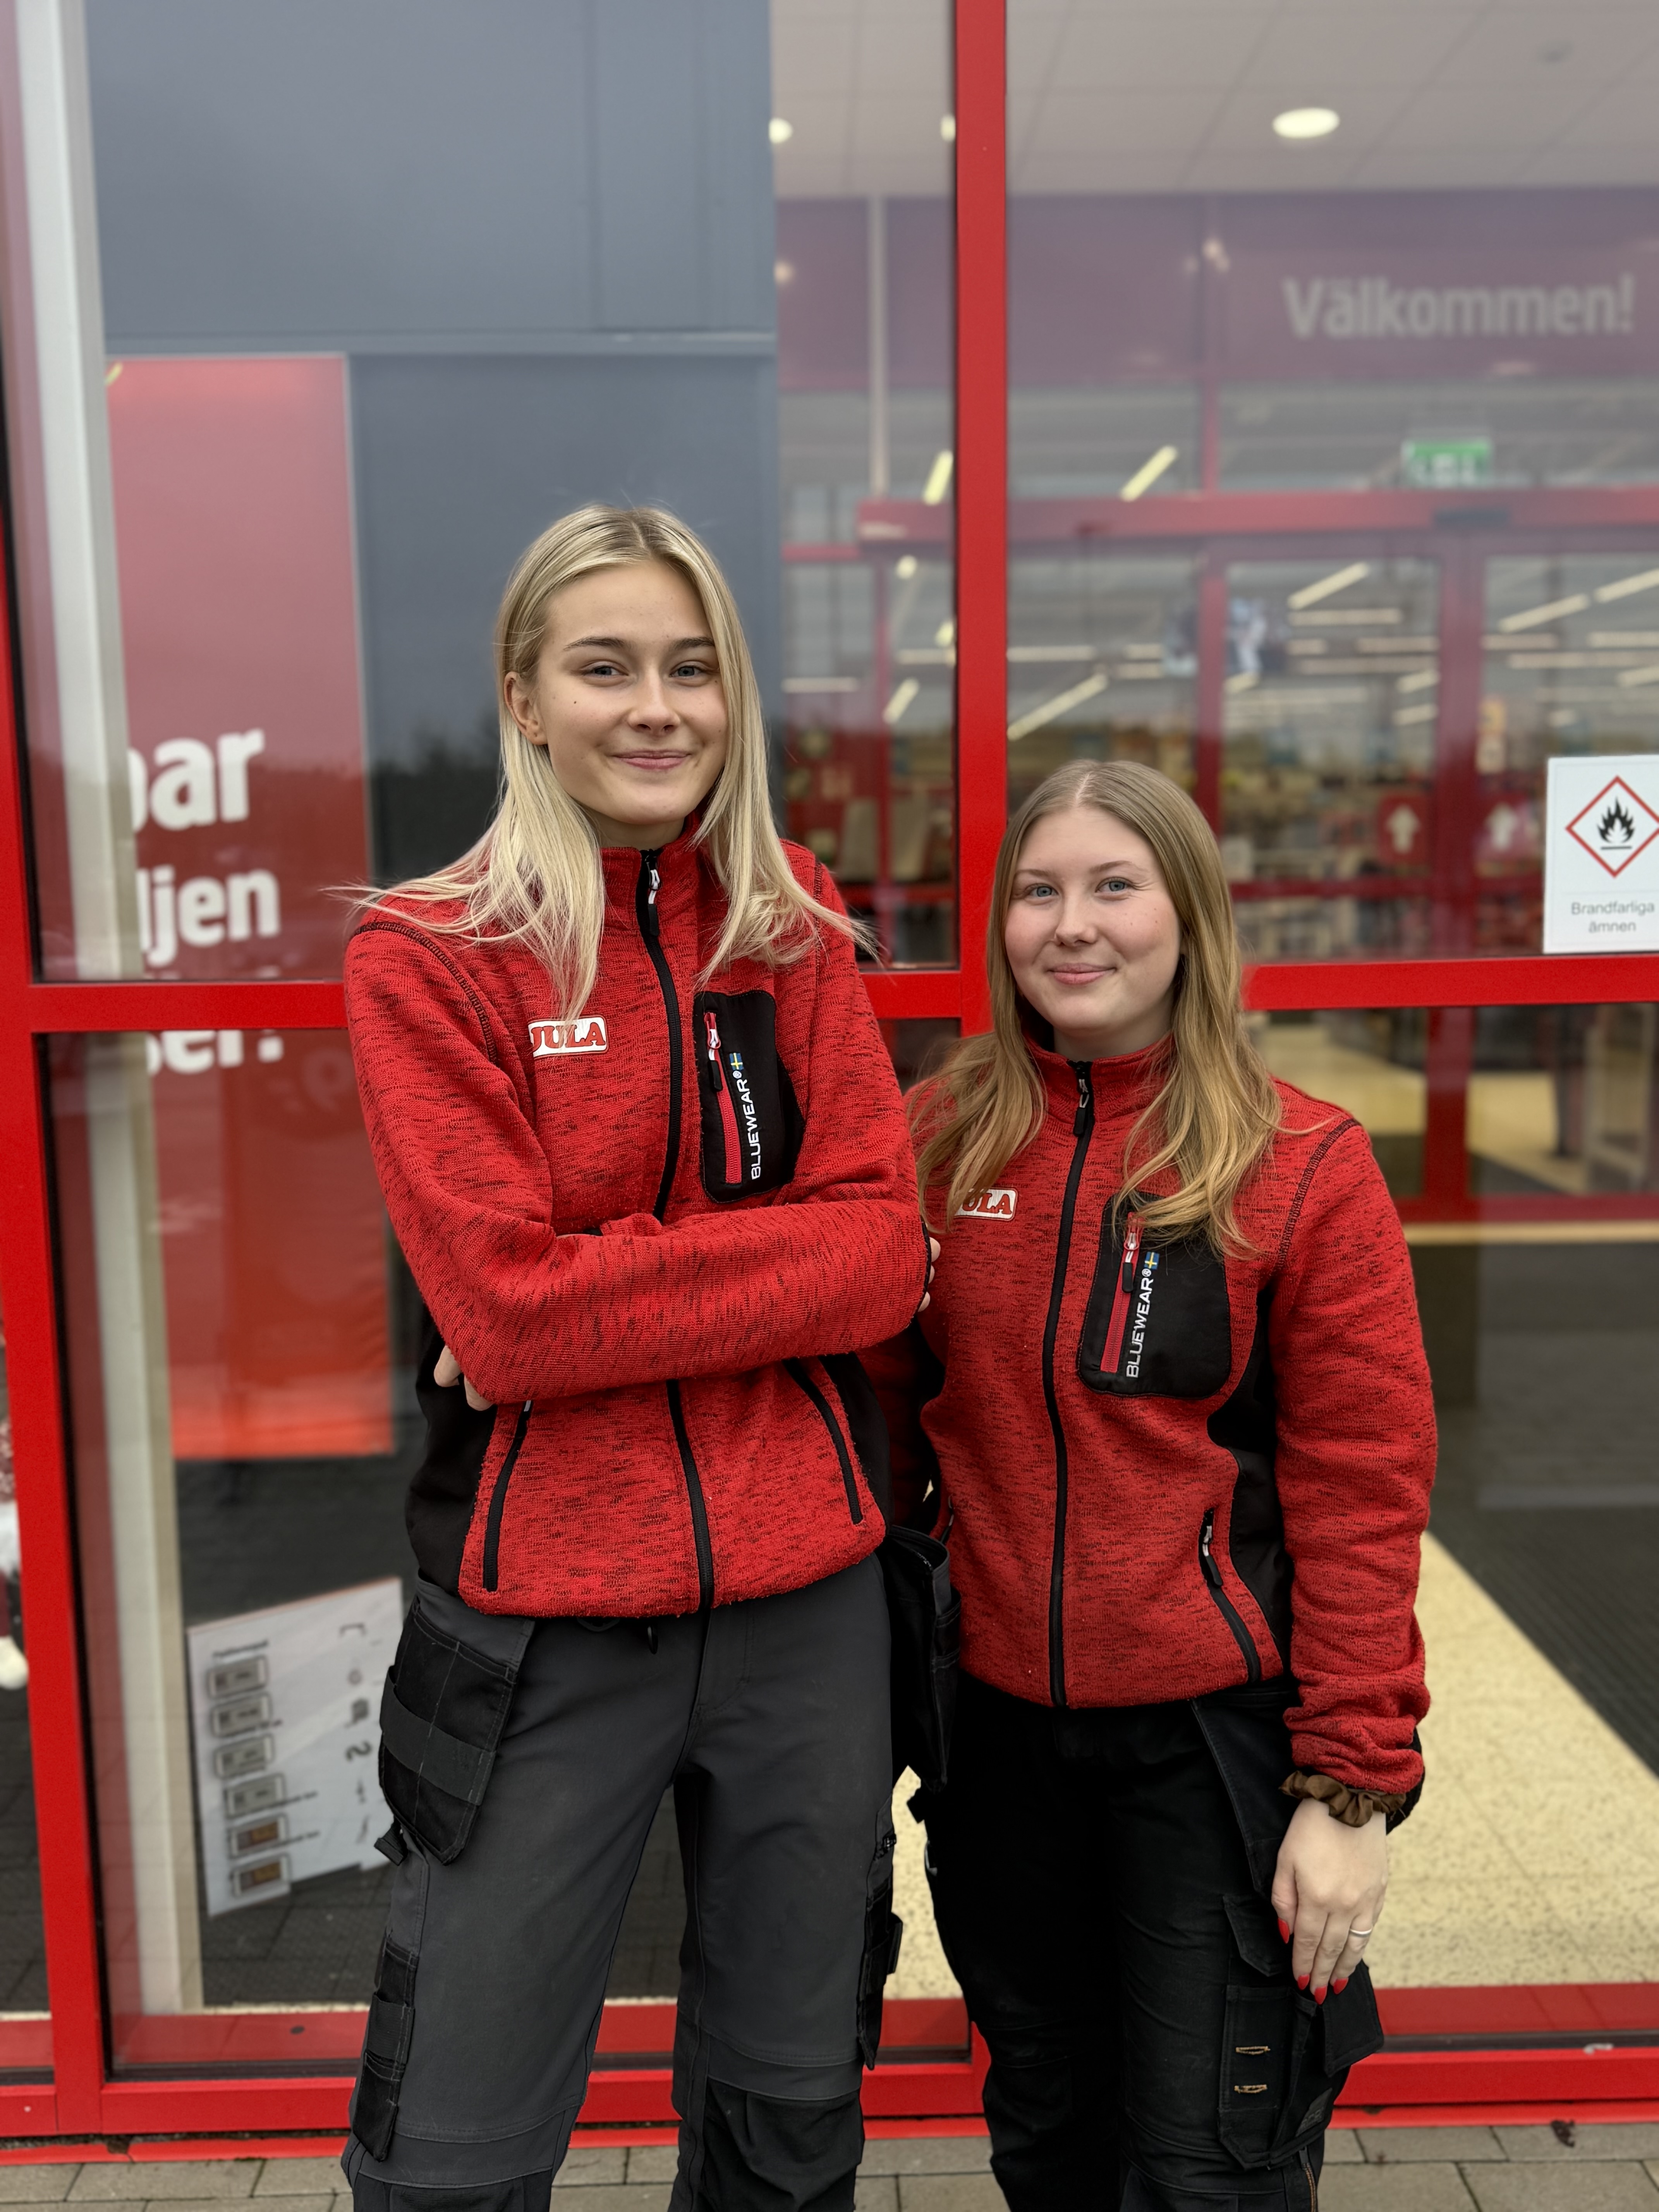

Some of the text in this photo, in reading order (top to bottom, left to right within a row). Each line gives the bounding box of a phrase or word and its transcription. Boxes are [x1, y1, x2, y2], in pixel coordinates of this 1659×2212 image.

[1282, 273, 1635, 338] Välkommen!
[128, 728, 265, 832] ar
[1571, 901, 1655, 916] Brandfarliga
[1589, 921, 1637, 933] ämnen
[531, 1022, 606, 1051] JULA
[962, 1192, 1012, 1215] ULA
